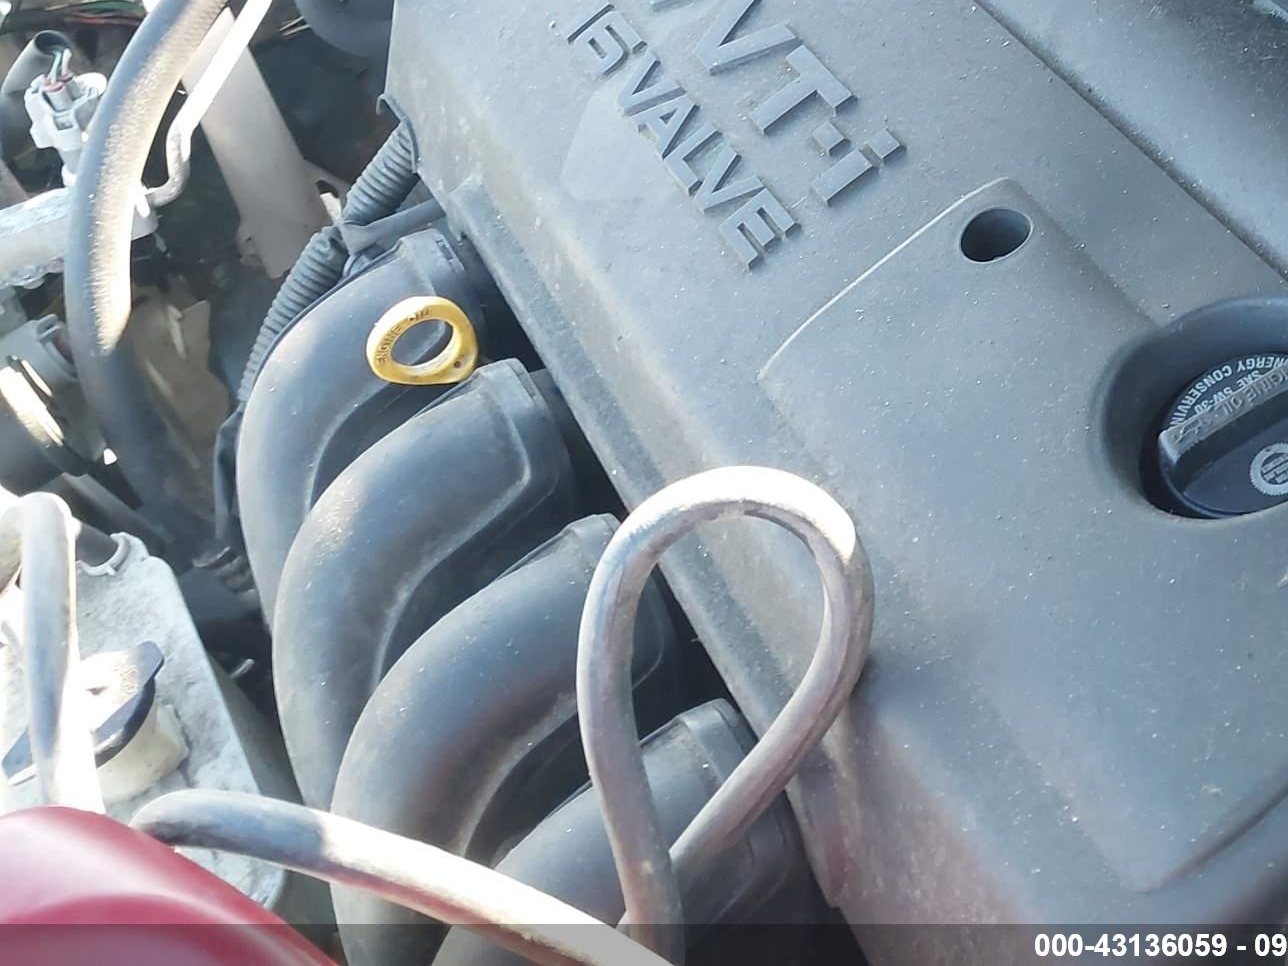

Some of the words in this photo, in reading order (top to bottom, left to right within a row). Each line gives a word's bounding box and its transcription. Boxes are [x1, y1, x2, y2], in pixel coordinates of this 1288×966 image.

[1237, 370, 1265, 389] SAE
[1170, 365, 1232, 427] CONSERVIN
[1193, 386, 1233, 414] 5W-30
